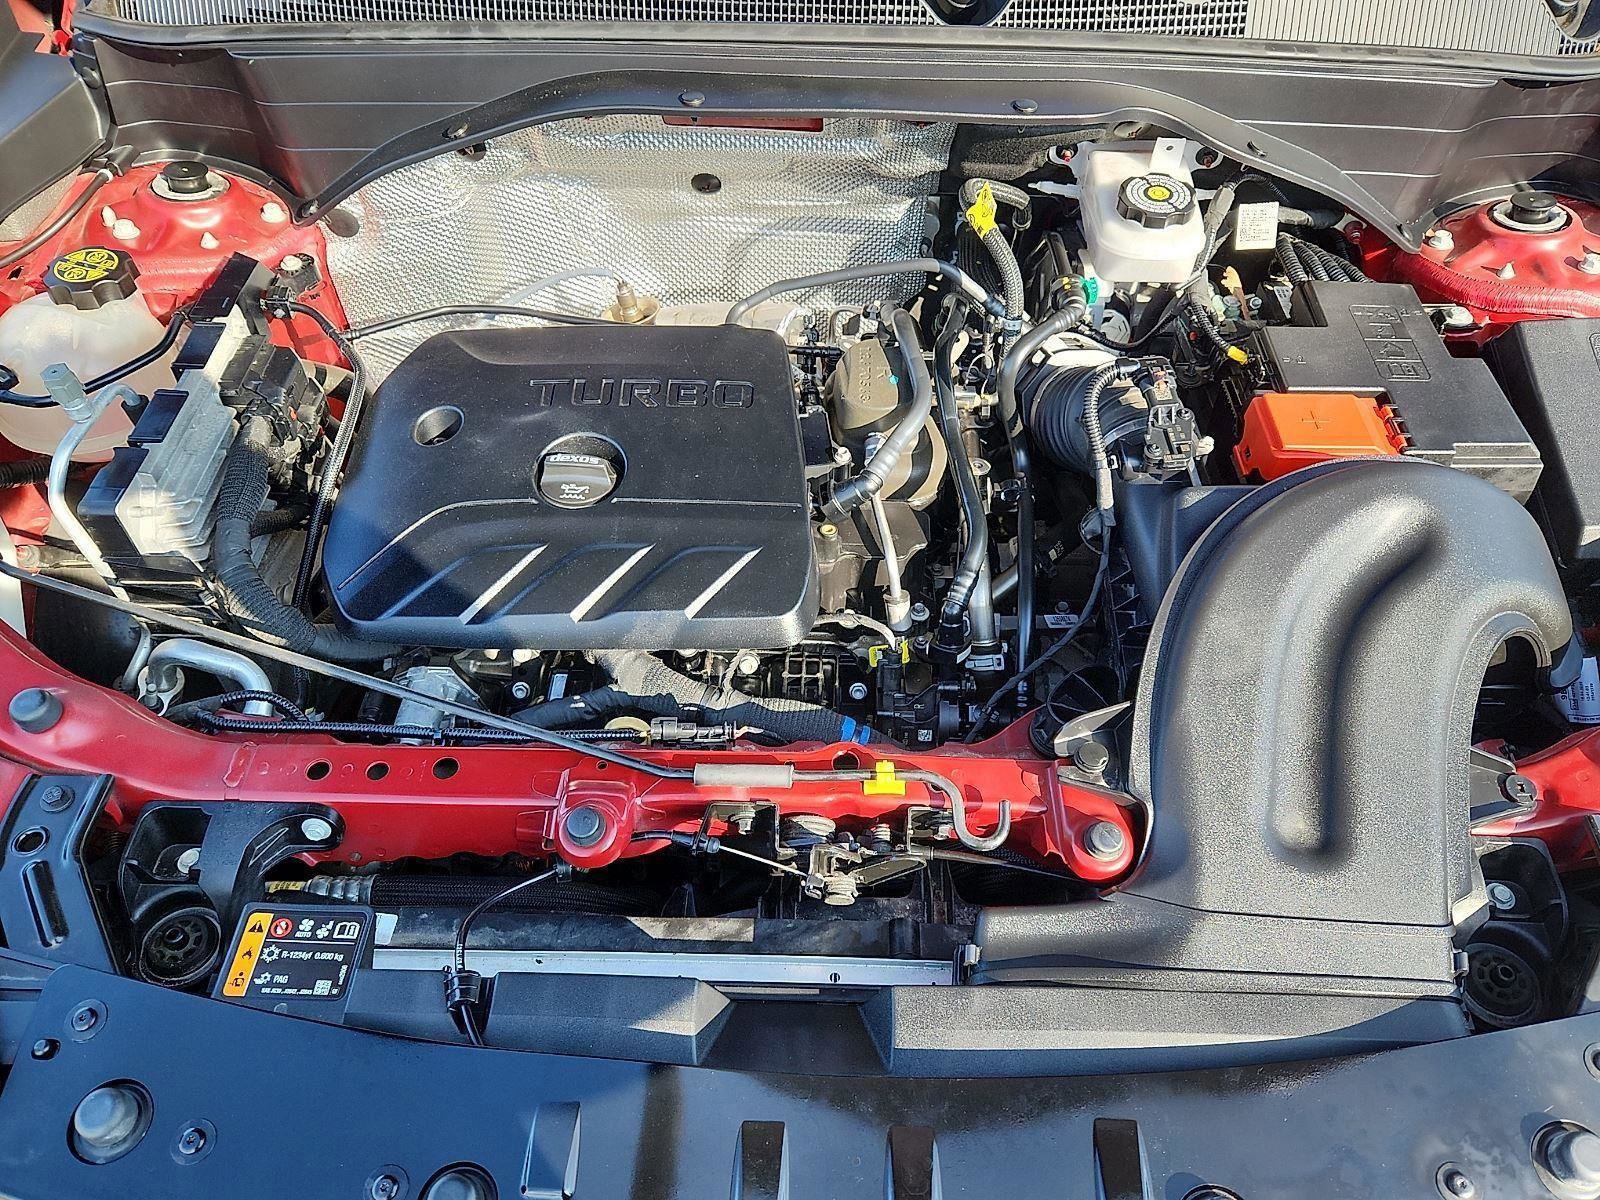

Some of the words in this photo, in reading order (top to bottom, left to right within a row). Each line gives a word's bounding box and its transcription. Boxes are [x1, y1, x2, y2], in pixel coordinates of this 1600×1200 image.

[529, 378, 756, 409] TURBO
[550, 453, 601, 465] dexos
[281, 950, 313, 960] R-1234yf
[334, 953, 344, 962] kg
[273, 975, 289, 984] PAG
